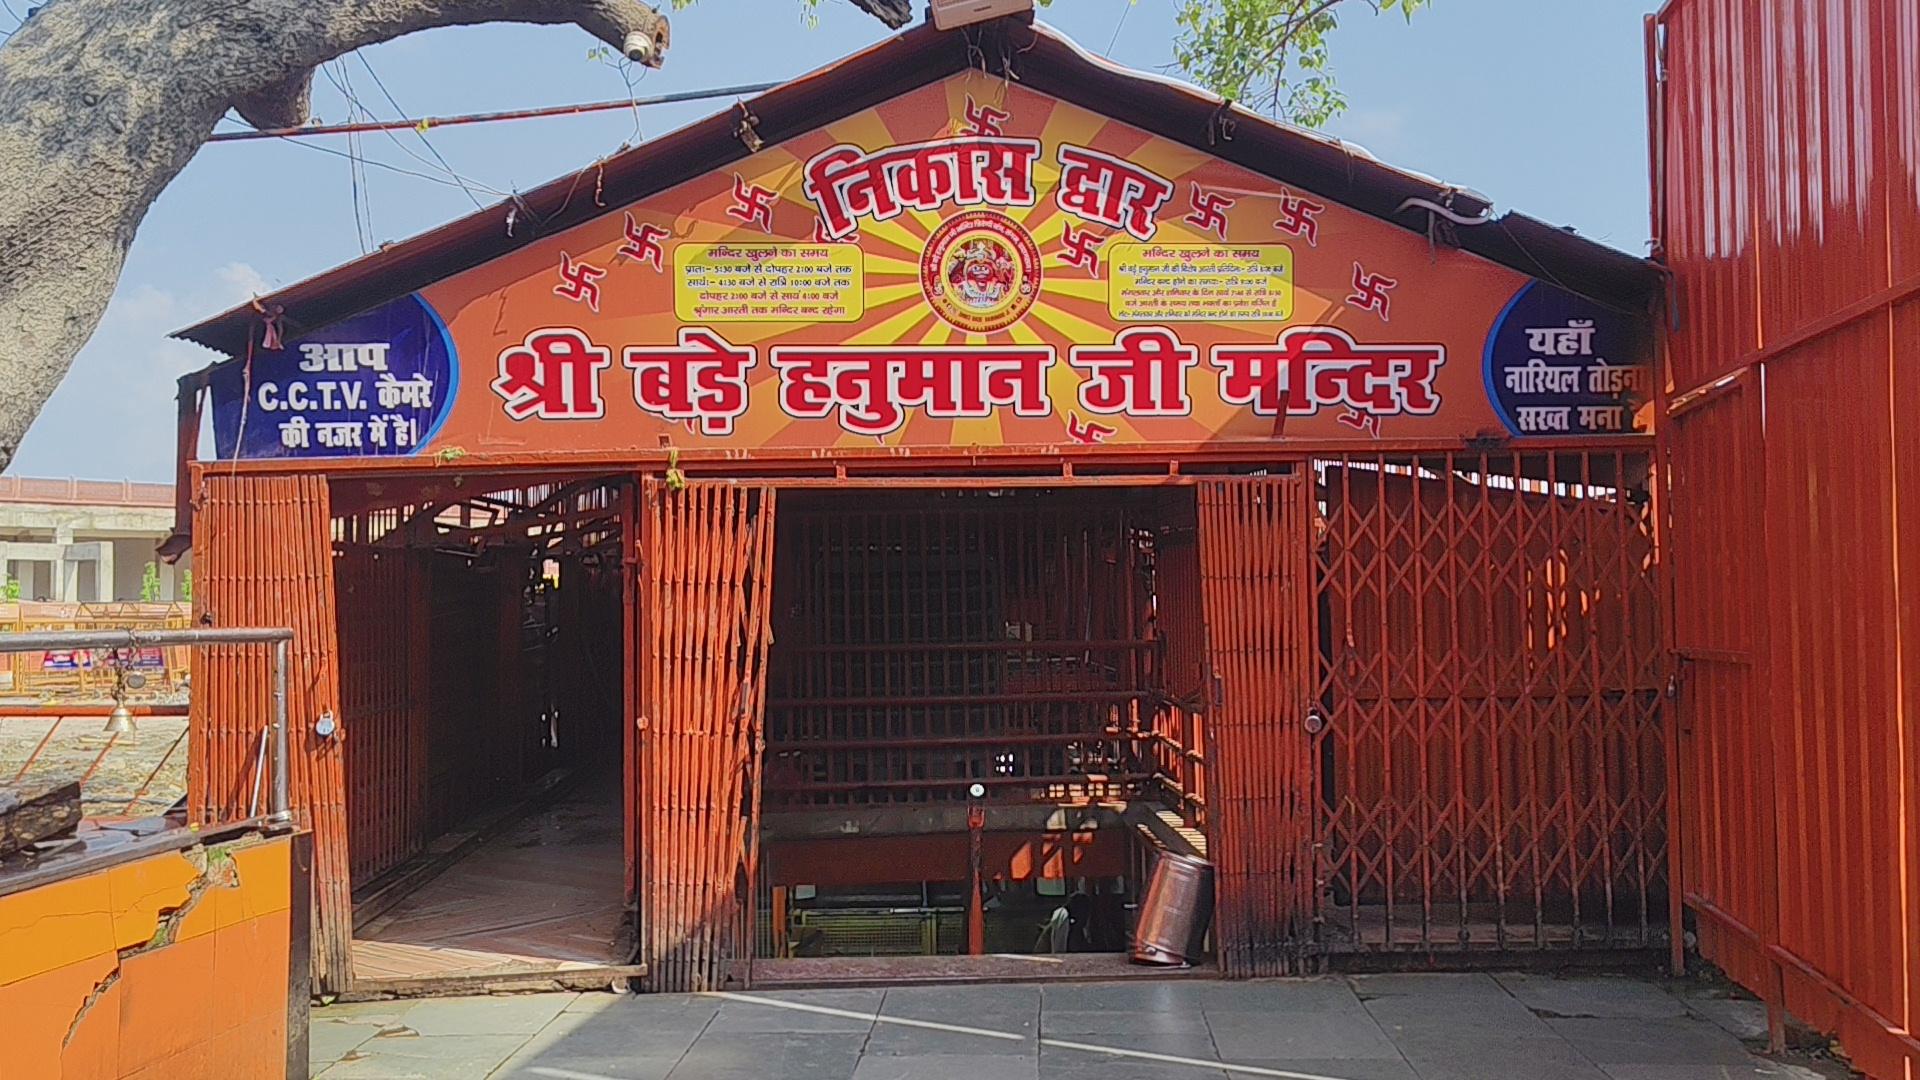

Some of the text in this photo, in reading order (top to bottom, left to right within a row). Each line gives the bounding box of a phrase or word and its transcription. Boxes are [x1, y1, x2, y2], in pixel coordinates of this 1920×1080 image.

[805, 138, 1174, 241] निकास द्वार
[708, 246, 828, 261] मन्दिर खुलने का समय
[1142, 246, 1259, 261] मन्दिर खुलने का समय
[735, 264, 751, 273] बजे
[754, 264, 762, 273] से
[765, 264, 793, 274] दोपहर
[817, 264, 832, 273] बजे
[738, 277, 755, 286] बजे
[758, 277, 766, 287] से
[769, 277, 787, 286] रात्रि
[790, 279, 812, 287] 10:00
[815, 277, 831, 286] बजे
[700, 290, 728, 300] दोपहर
[730, 292, 748, 300] 2:00
[751, 290, 767, 300] बजे
[770, 290, 778, 300] से
[822, 290, 839, 300] बजे
[721, 304, 748, 314] आरती
[751, 306, 768, 314] तक
[770, 304, 798, 314] मन्दिर
[822, 304, 845, 315] रहेगा
[1525, 320, 1595, 355] यहाँ
[299, 343, 390, 372] आप
[258, 373, 433, 411] C.C.T.V. कैमरे
[490, 325, 1447, 435] श्री बड़े हनुमान जी मन्दिर
[1504, 358, 1649, 399] नारियल तोड़ना
[278, 416, 310, 448] की
[315, 422, 363, 447] नजर
[368, 414, 389, 447] में
[1516, 406, 1624, 431] सख्त मना
